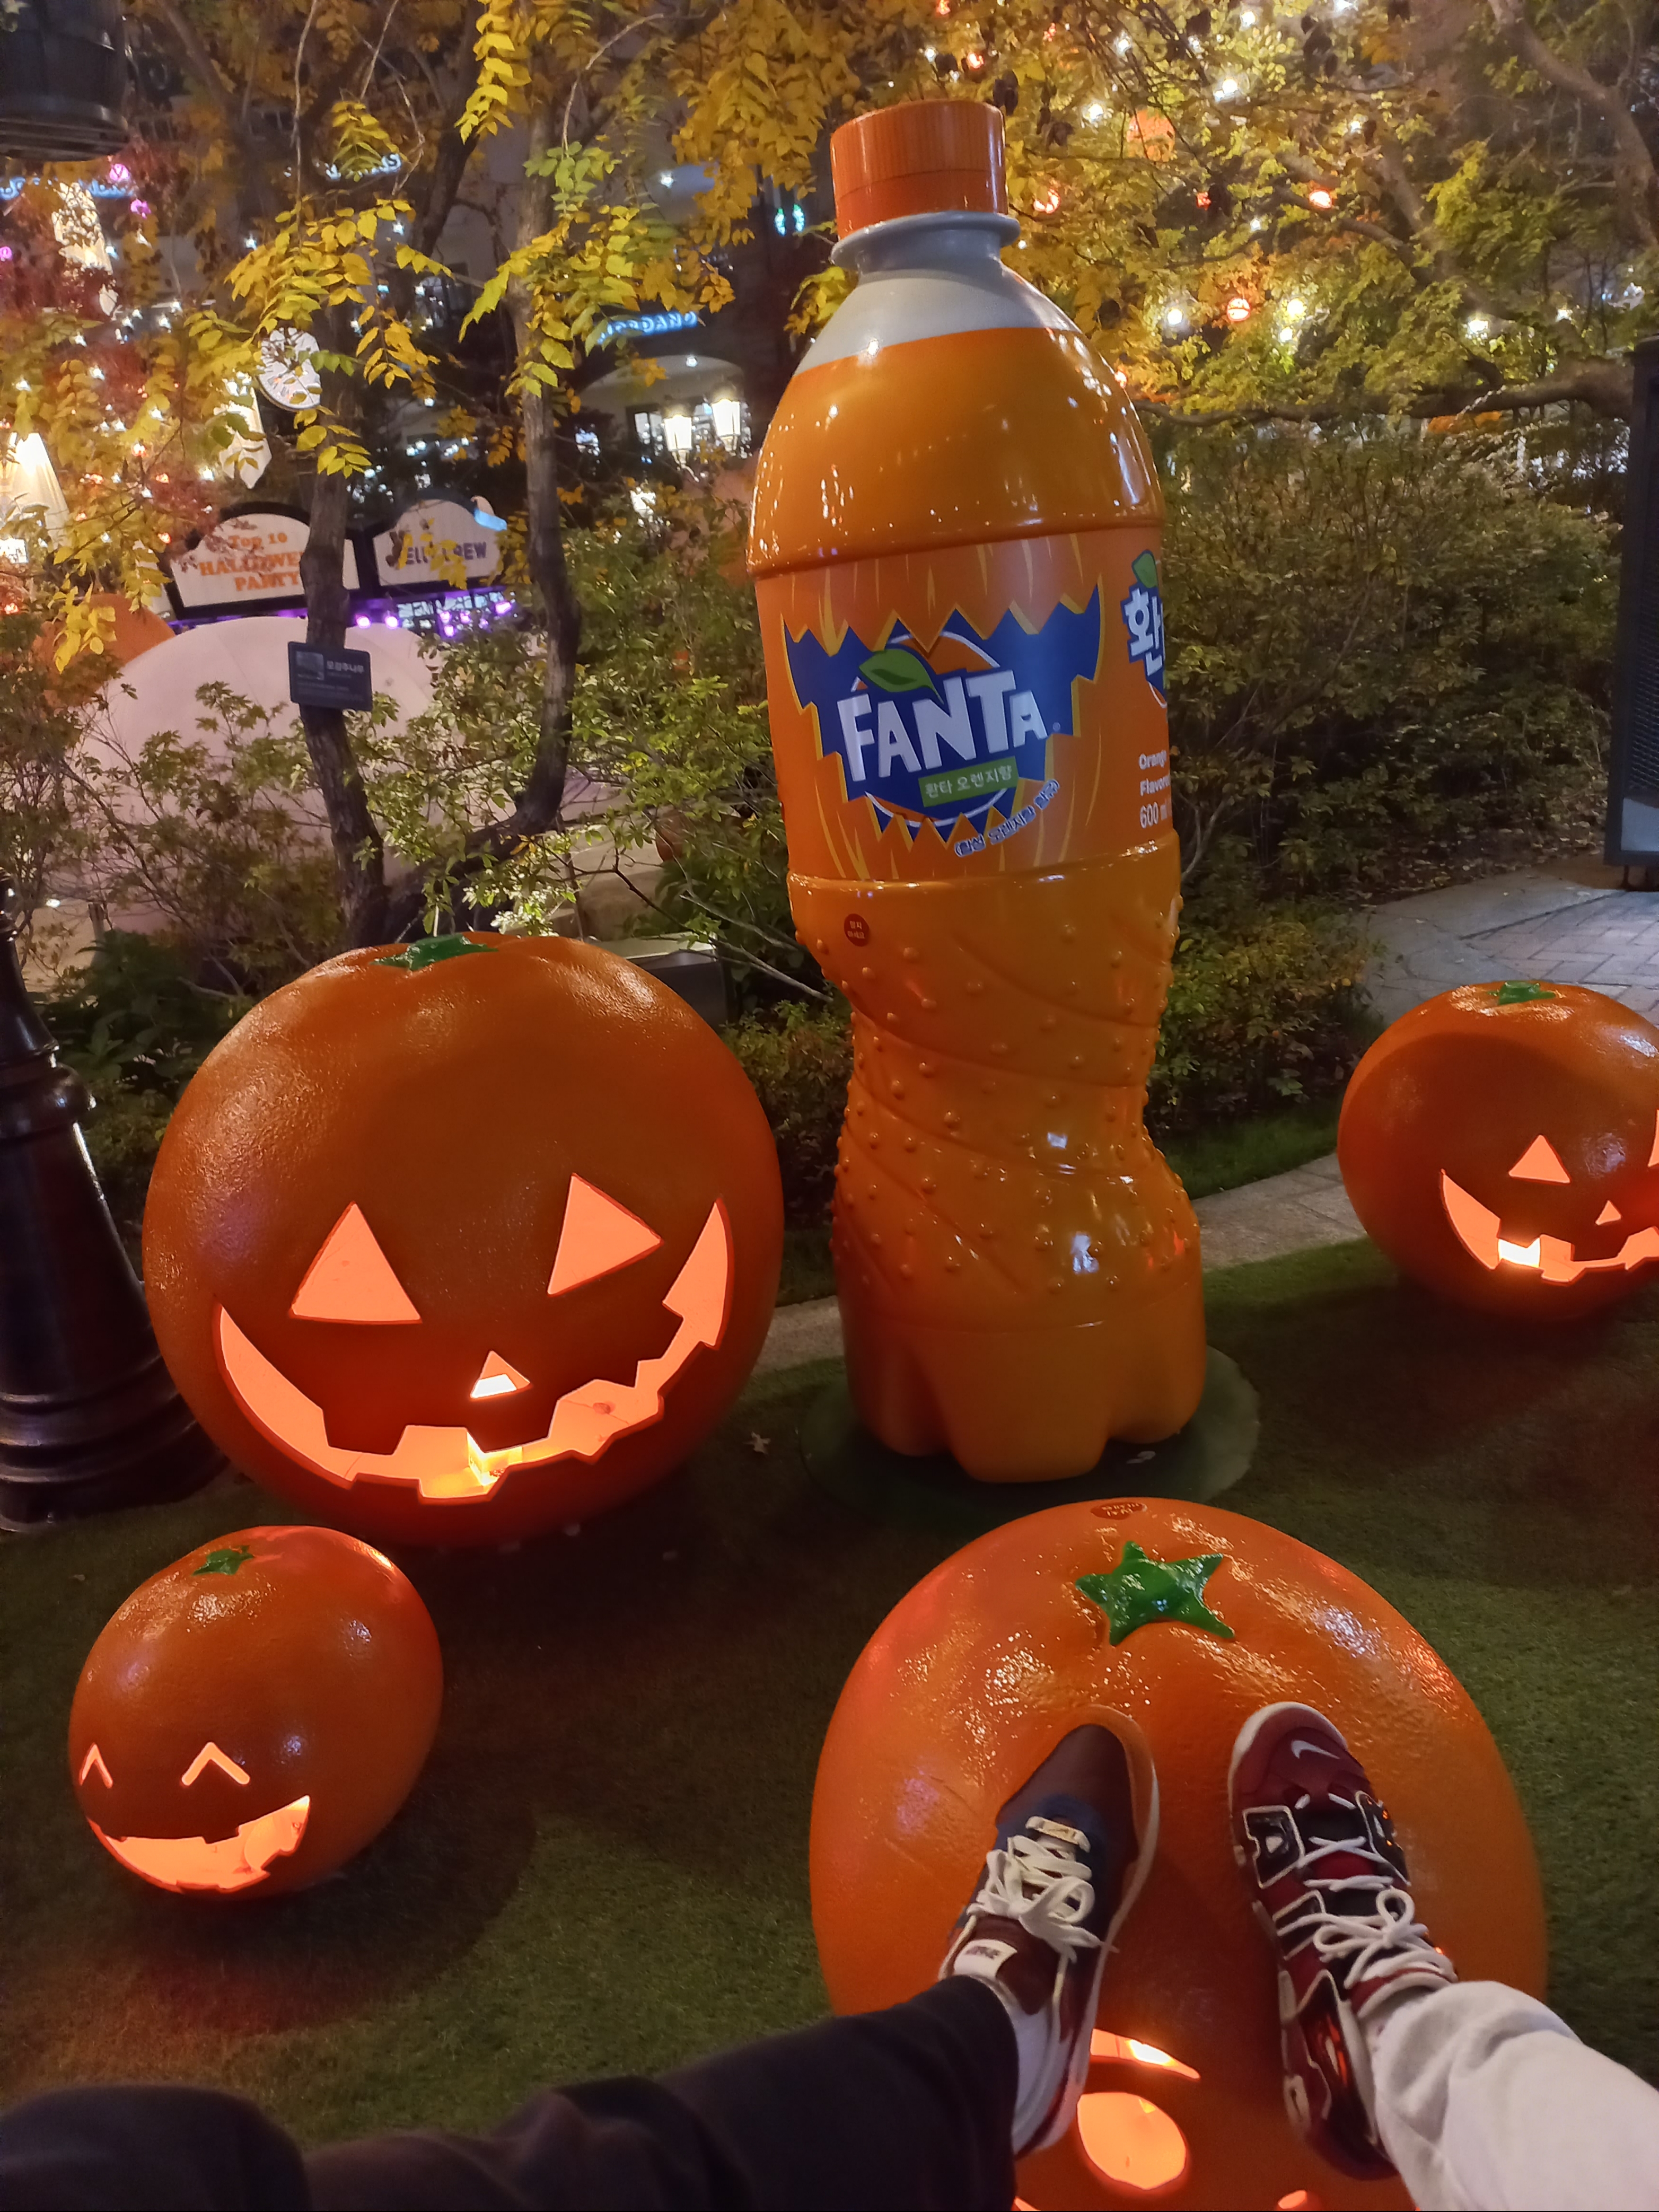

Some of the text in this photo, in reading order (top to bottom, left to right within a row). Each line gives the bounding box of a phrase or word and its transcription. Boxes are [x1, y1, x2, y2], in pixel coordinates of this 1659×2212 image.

[268, 532, 287, 544] 10
[1124, 587, 1165, 677] 환
[836, 670, 1048, 782] FANTA
[925, 765, 1013, 798] 환타 오렌지향
[1140, 802, 1158, 829] 600
